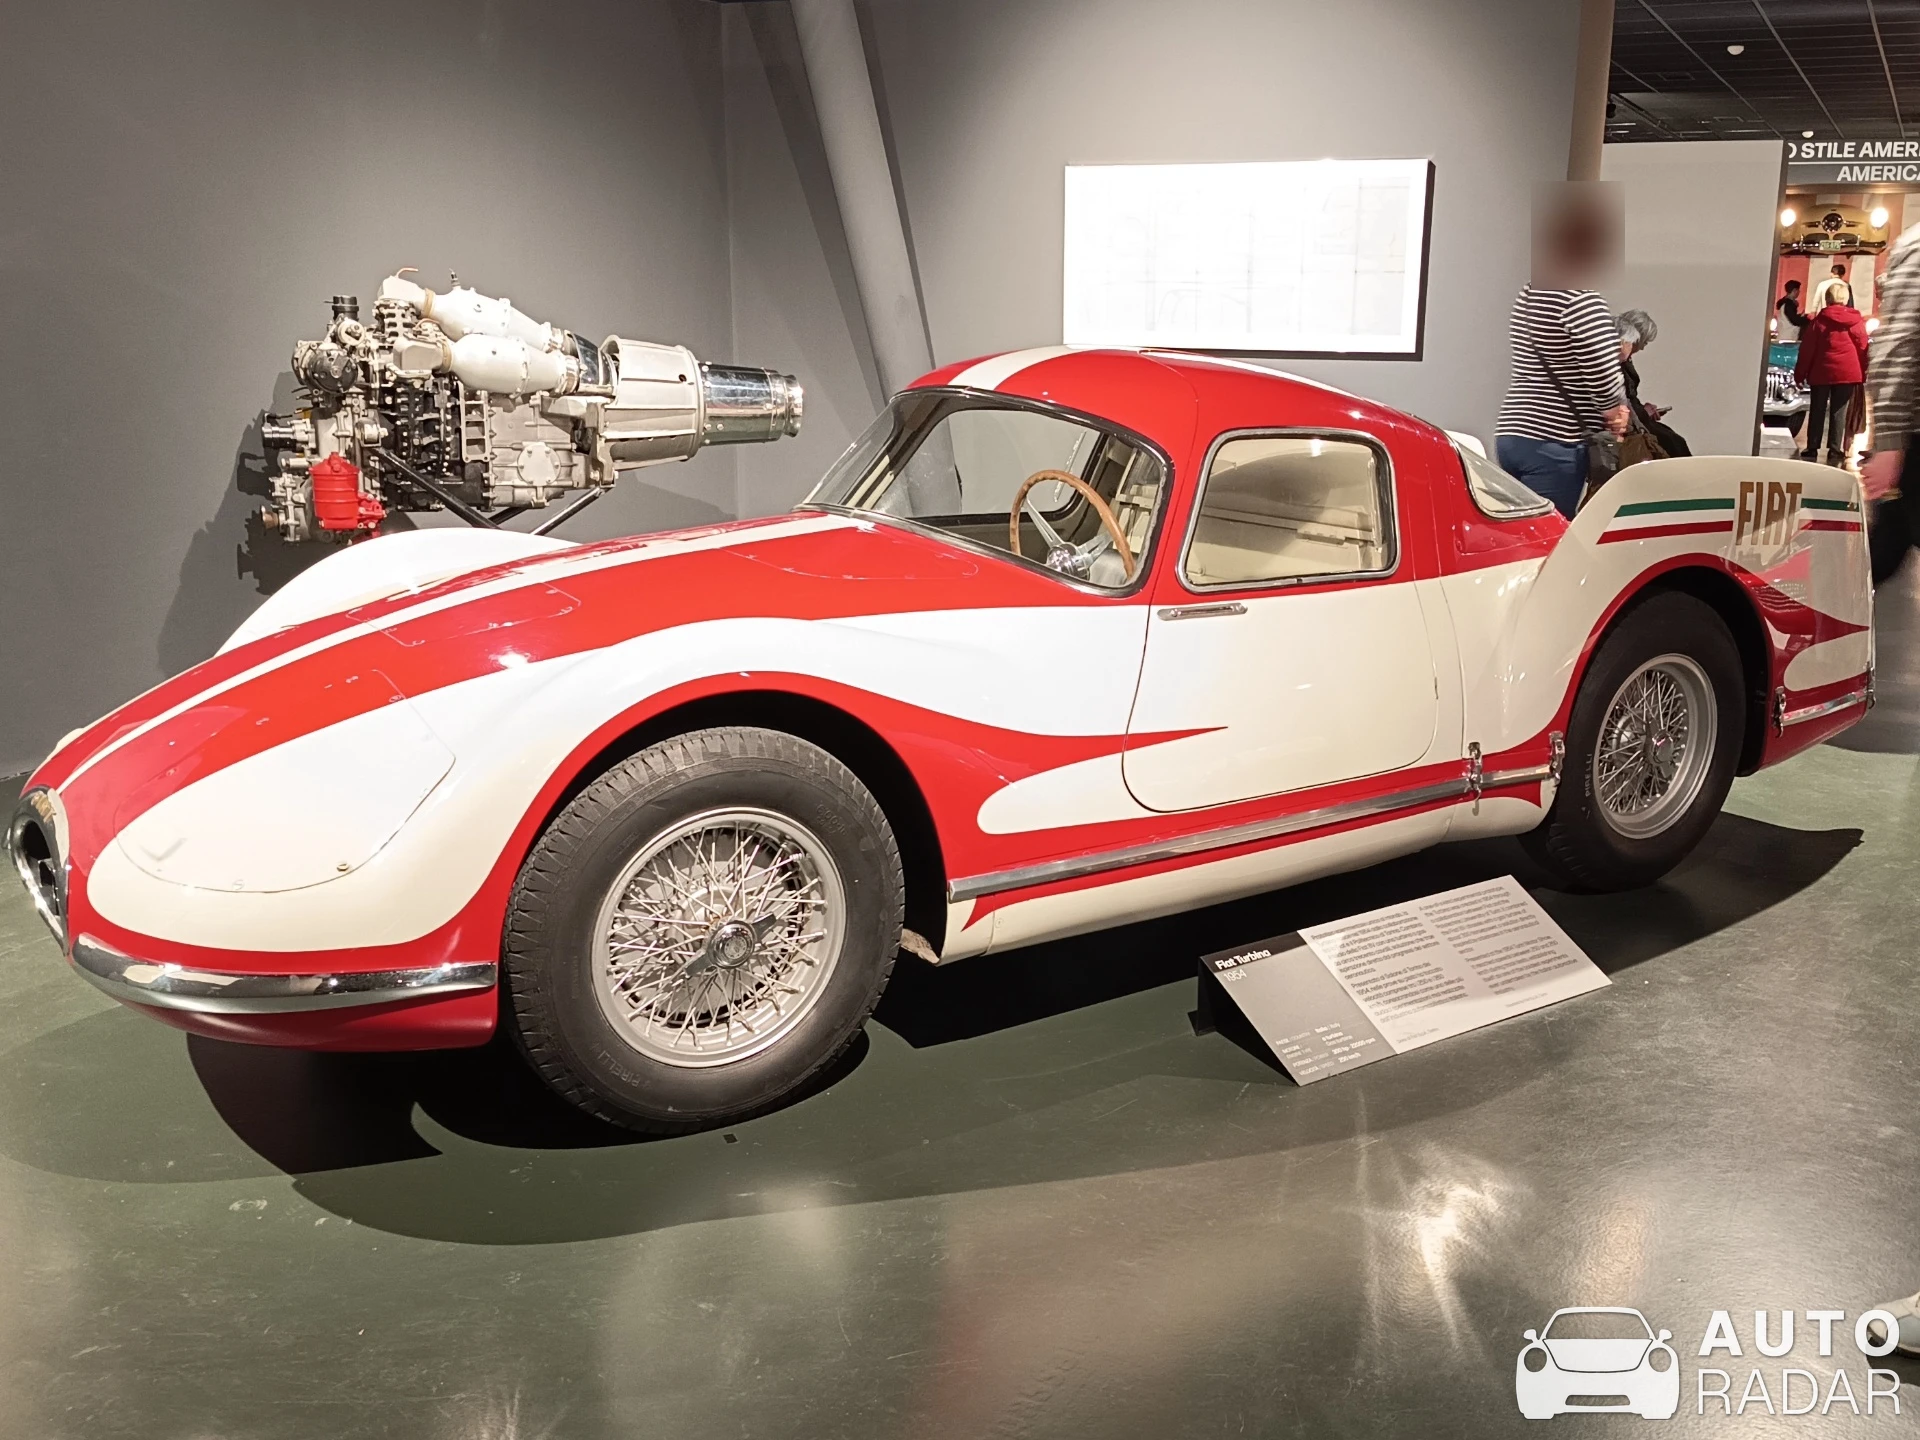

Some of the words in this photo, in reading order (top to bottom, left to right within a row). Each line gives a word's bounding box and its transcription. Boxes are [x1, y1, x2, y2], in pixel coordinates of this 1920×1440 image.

[1801, 142, 1856, 159] STILE
[1859, 141, 1920, 158] AMER
[1836, 165, 1920, 182] AMERIC
[1735, 481, 1803, 546] FIAT
[1215, 957, 1237, 970] Fiat
[1233, 949, 1271, 965] Turbina
[1223, 968, 1247, 981] 1954
[597, 1050, 641, 1088] PIRELLI
